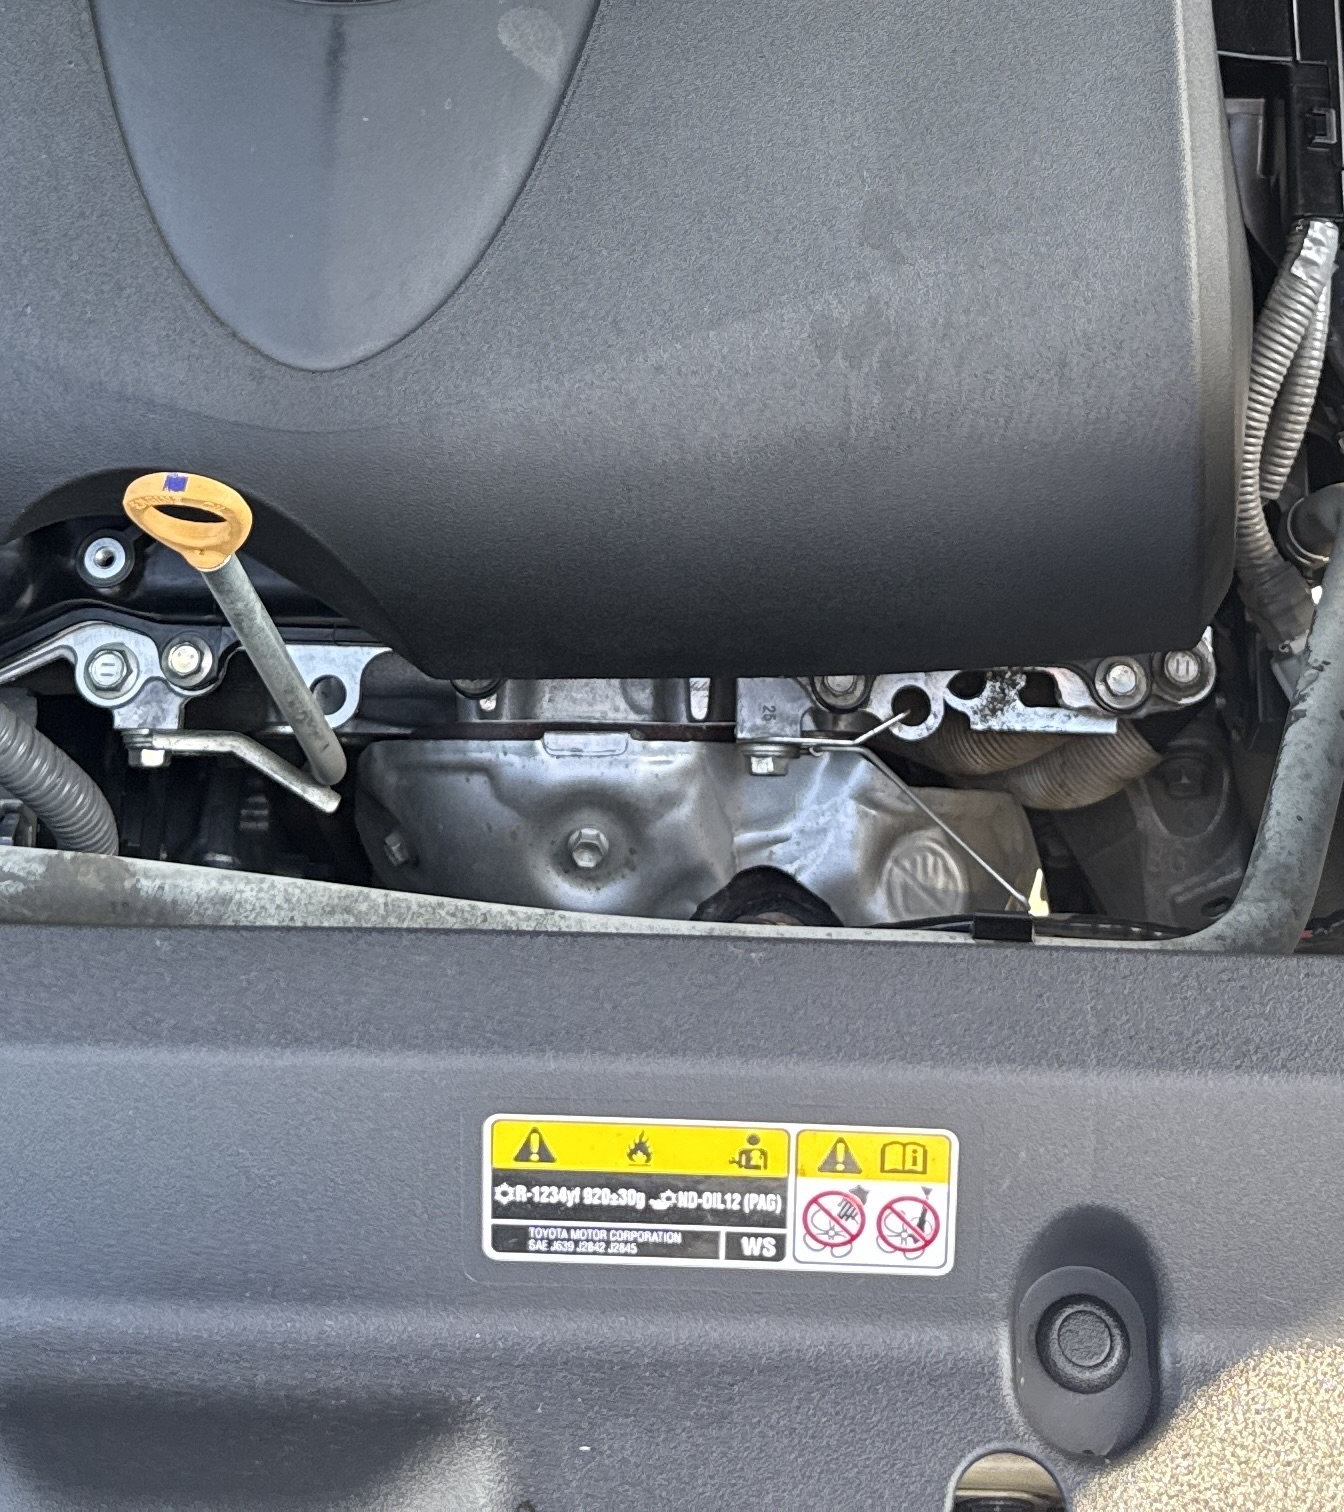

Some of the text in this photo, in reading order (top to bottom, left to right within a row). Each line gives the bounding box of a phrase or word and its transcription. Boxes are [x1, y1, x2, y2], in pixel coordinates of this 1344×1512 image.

[515, 1184, 782, 1215] R-1234yf 920±30g ND-OIL12 (PAG)
[528, 1227, 682, 1243] TOYOTA MOTOR CORPORATION
[528, 1239, 638, 1254] SAE J639 J2842 J2845
[741, 1236, 777, 1258] WS
